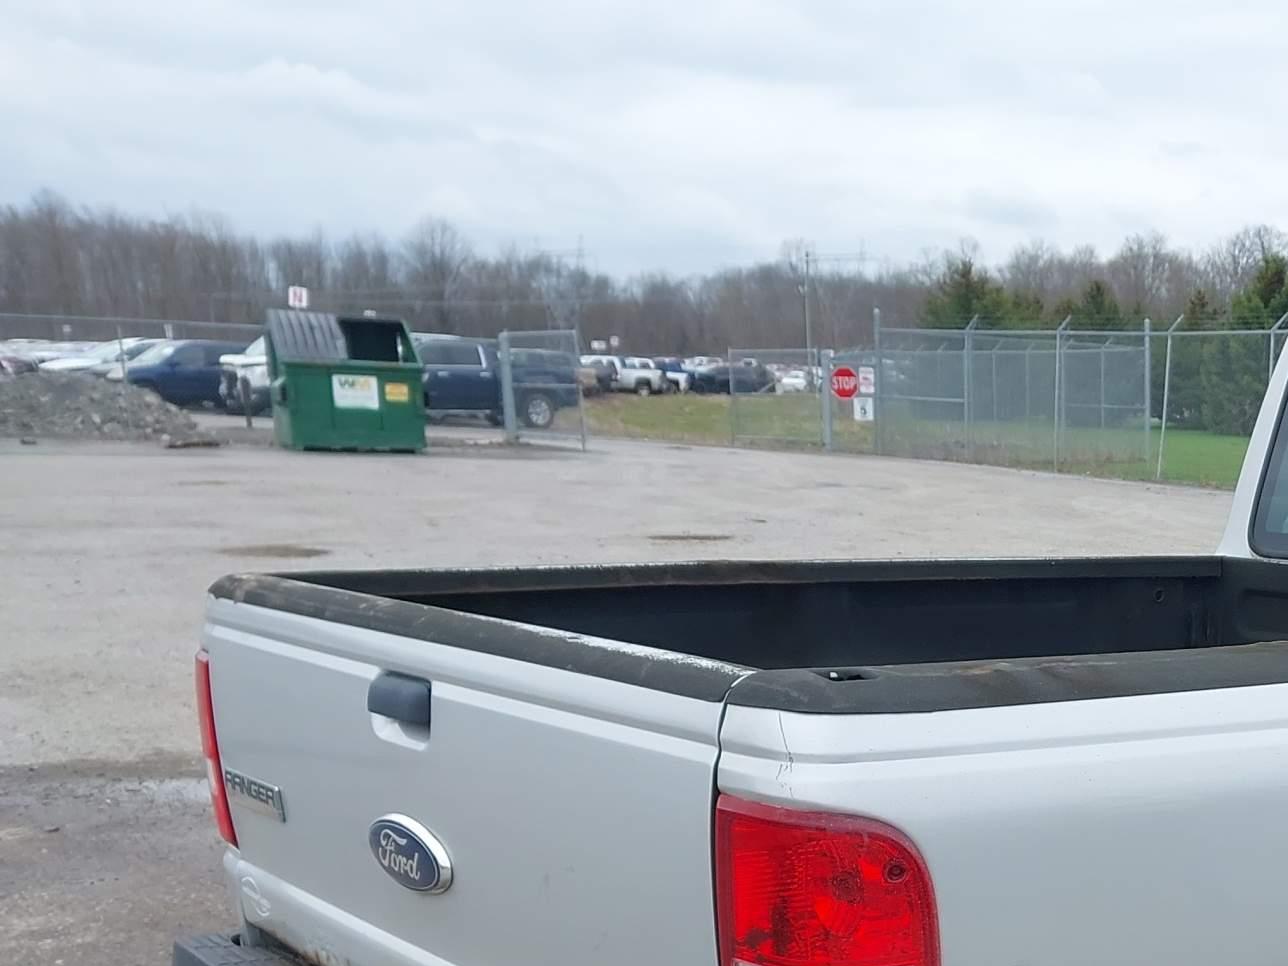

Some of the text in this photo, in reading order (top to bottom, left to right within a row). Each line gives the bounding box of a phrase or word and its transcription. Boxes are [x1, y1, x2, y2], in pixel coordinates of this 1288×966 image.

[832, 375, 857, 390] STOP
[224, 770, 276, 809] RANGER
[378, 828, 421, 880] Ford
